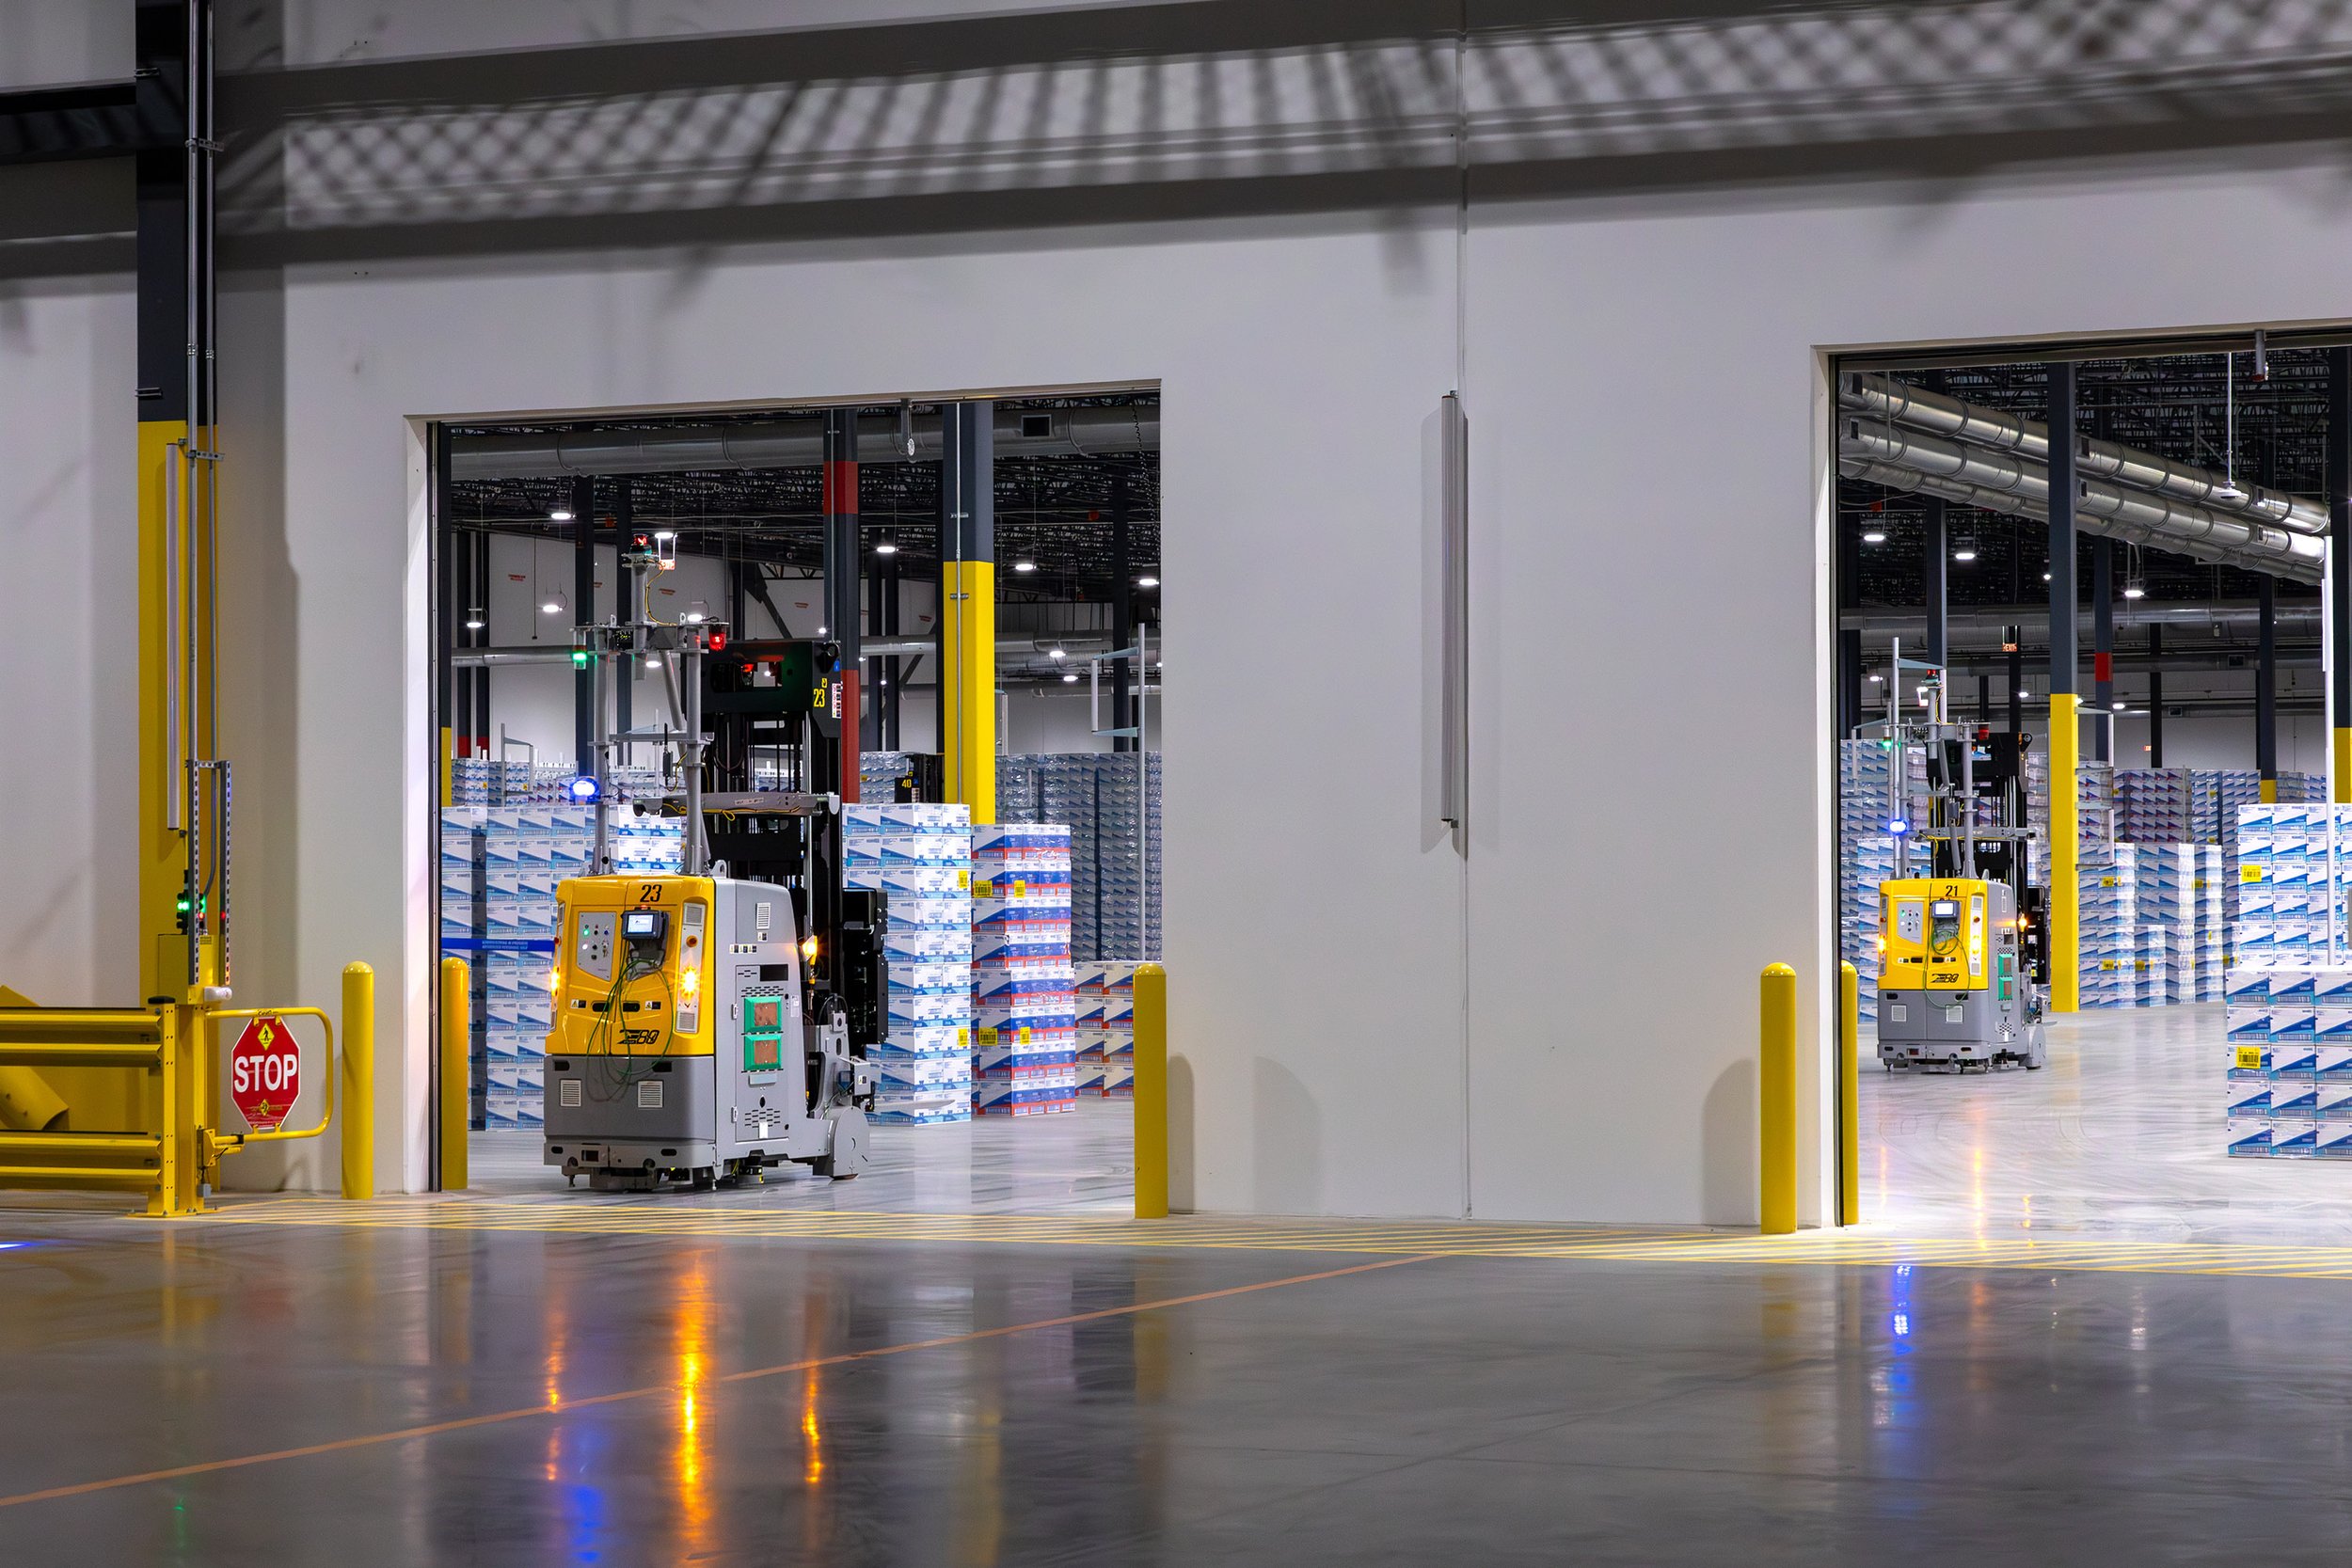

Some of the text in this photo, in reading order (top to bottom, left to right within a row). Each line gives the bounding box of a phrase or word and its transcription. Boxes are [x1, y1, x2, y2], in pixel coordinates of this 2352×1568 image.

[813, 689, 826, 707] 23
[640, 884, 662, 903] 23
[1945, 884, 1958, 897] 21
[233, 1053, 298, 1093] STOP
